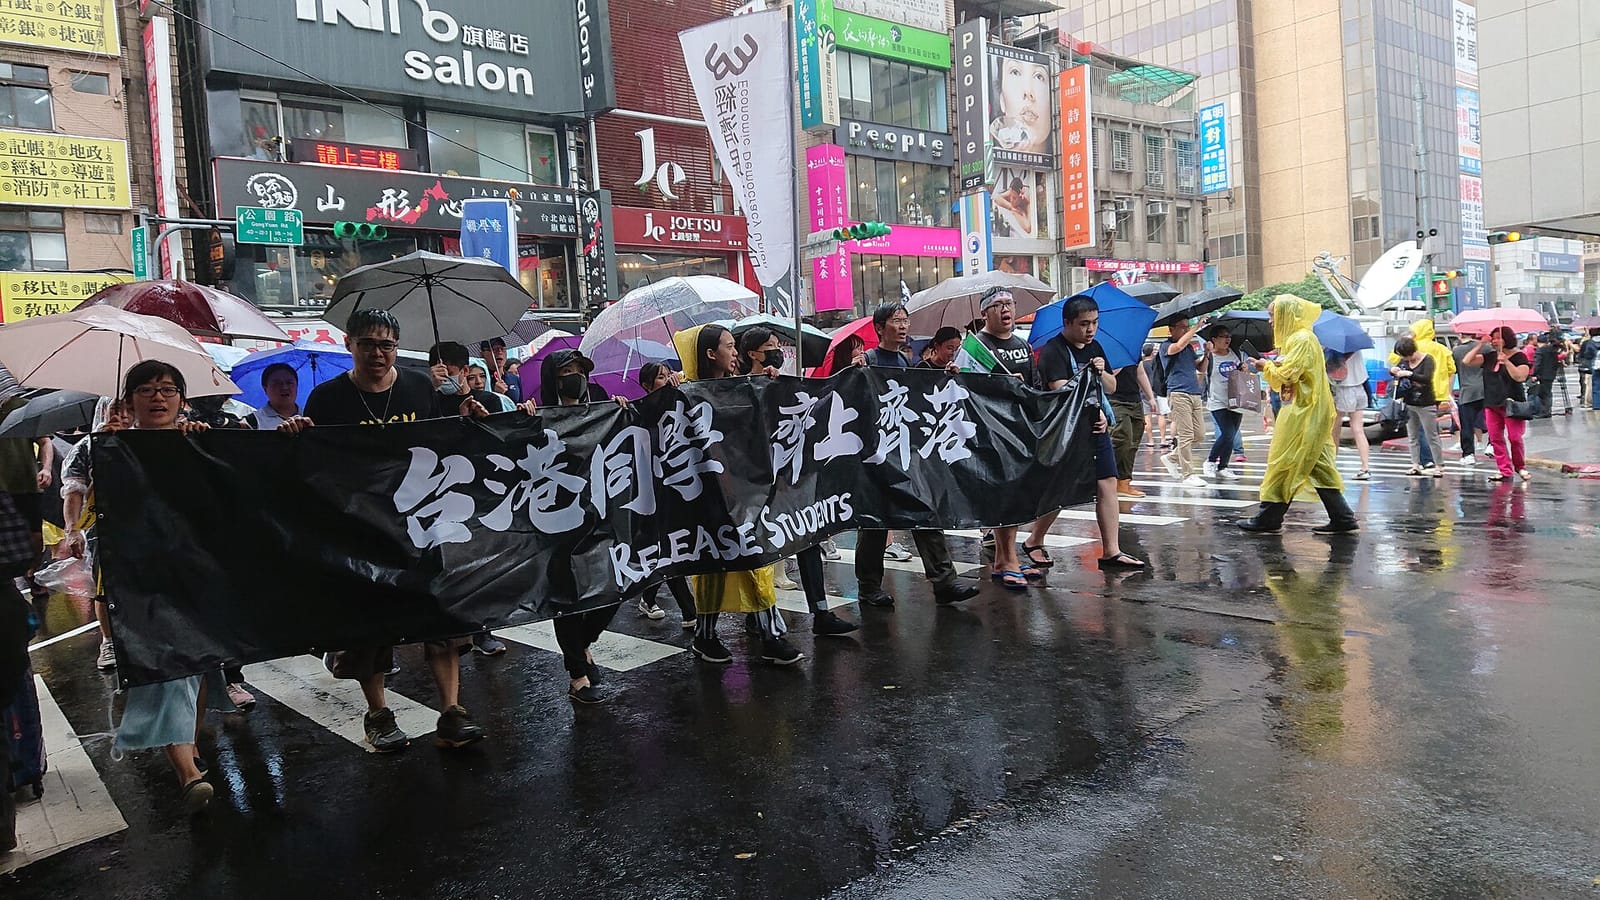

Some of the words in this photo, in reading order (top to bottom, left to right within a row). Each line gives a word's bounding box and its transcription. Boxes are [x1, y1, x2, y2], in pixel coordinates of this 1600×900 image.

[58, 1, 92, 20] 企銀
[60, 25, 96, 46] 捷運
[462, 24, 529, 55] 旗艦店
[404, 50, 535, 96] salon
[583, 74, 594, 98] 3F
[849, 122, 944, 153] People
[10, 138, 45, 156] 記帳
[69, 144, 103, 161] 地政
[317, 144, 399, 169] 請上三樓
[11, 159, 47, 176] 經紀
[71, 163, 104, 180] 導遊
[13, 179, 48, 197] 消防
[73, 184, 106, 199] 社工
[966, 177, 980, 187] 3F
[670, 216, 722, 232] JOETSU
[23, 281, 58, 296] 移民
[394, 401, 724, 549] 台港同學
[770, 379, 977, 486] 齊上齊落
[609, 522, 764, 587] RELEASE
[759, 492, 853, 548] STUDENTS
